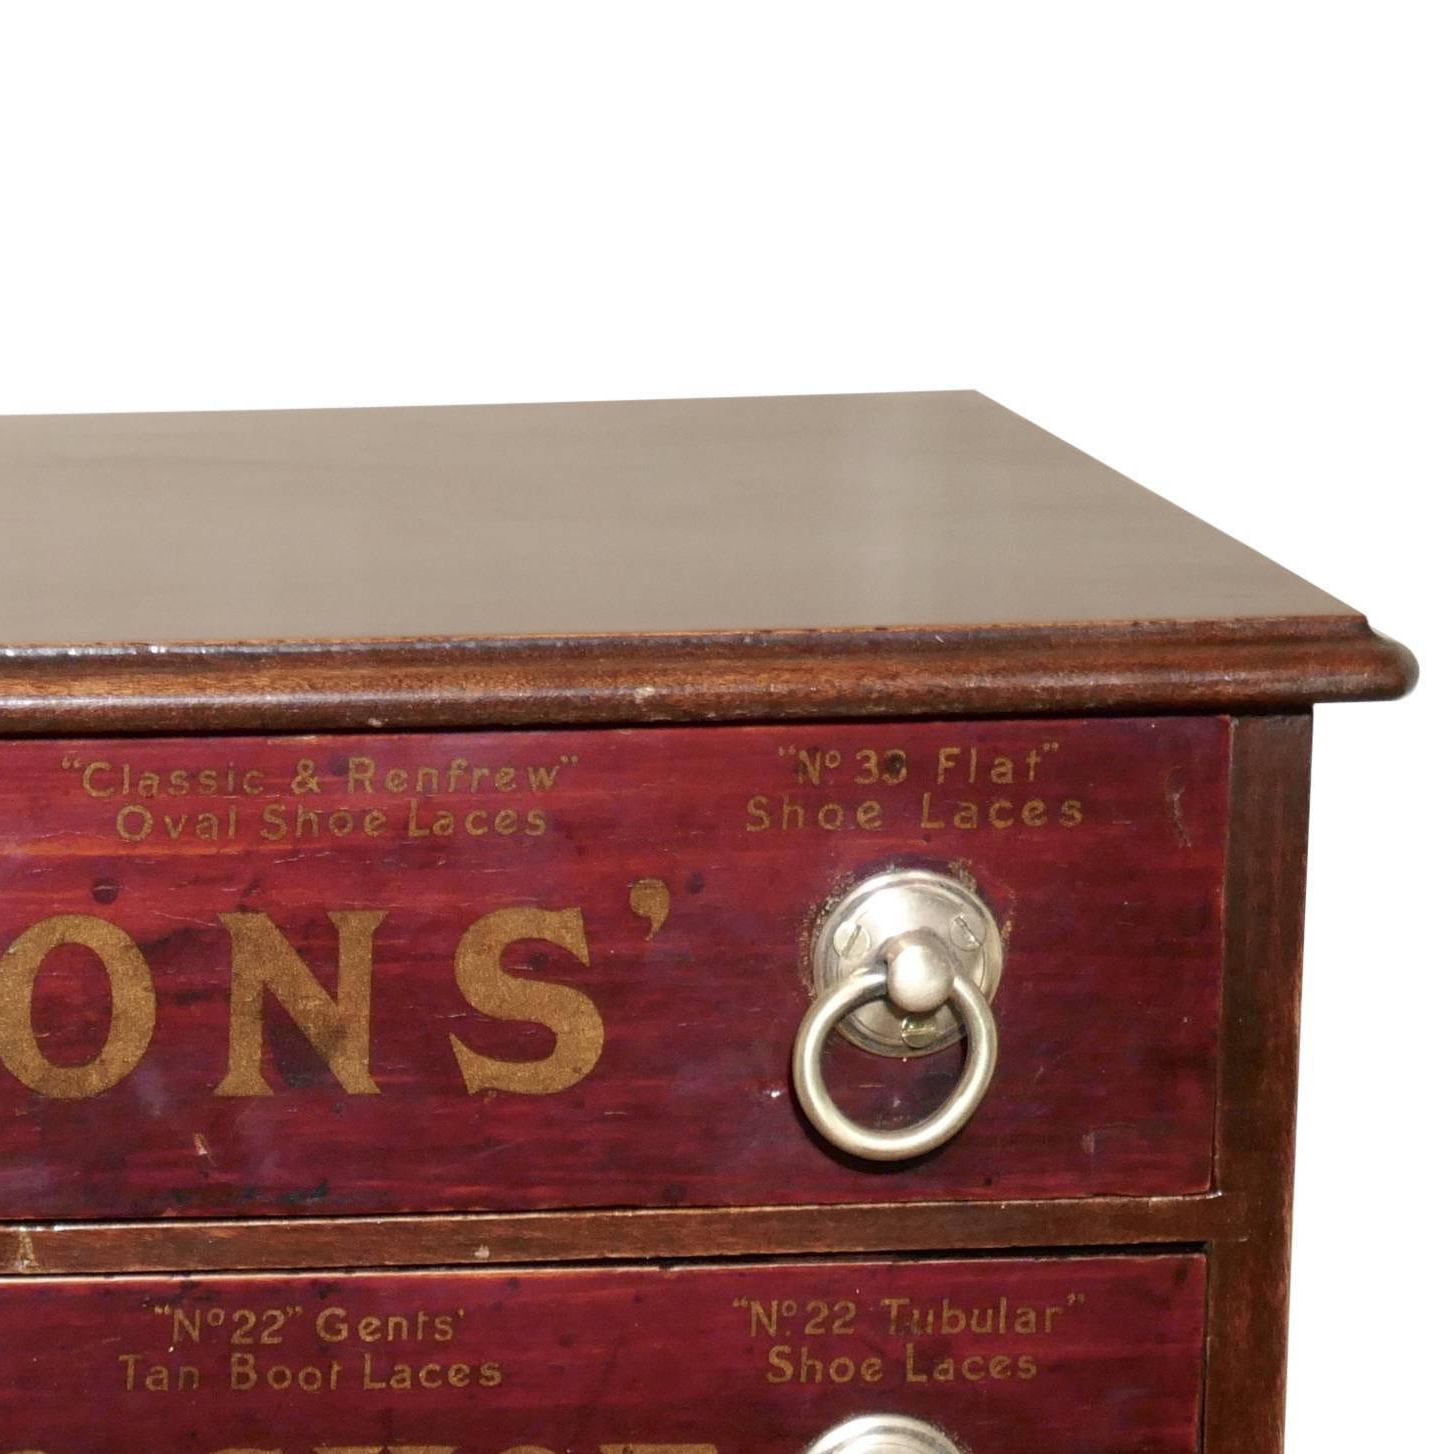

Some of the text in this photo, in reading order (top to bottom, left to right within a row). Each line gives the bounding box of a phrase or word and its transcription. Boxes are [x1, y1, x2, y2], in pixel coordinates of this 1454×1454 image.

[61, 754, 579, 798] "Classic & Renfrew"
[937, 742, 1060, 785] Flat"
[116, 798, 547, 841] Oval Shoe Laces
[746, 791, 1084, 832] Shoe Laces
[230, 1305, 303, 1345] 22"
[315, 1306, 465, 1343] Gents'
[804, 1300, 858, 1336] 22
[881, 1293, 1085, 1336] Tubular"
[118, 1352, 503, 1392] Tan Boot Laces
[766, 1343, 1038, 1384] Shoe Laces
